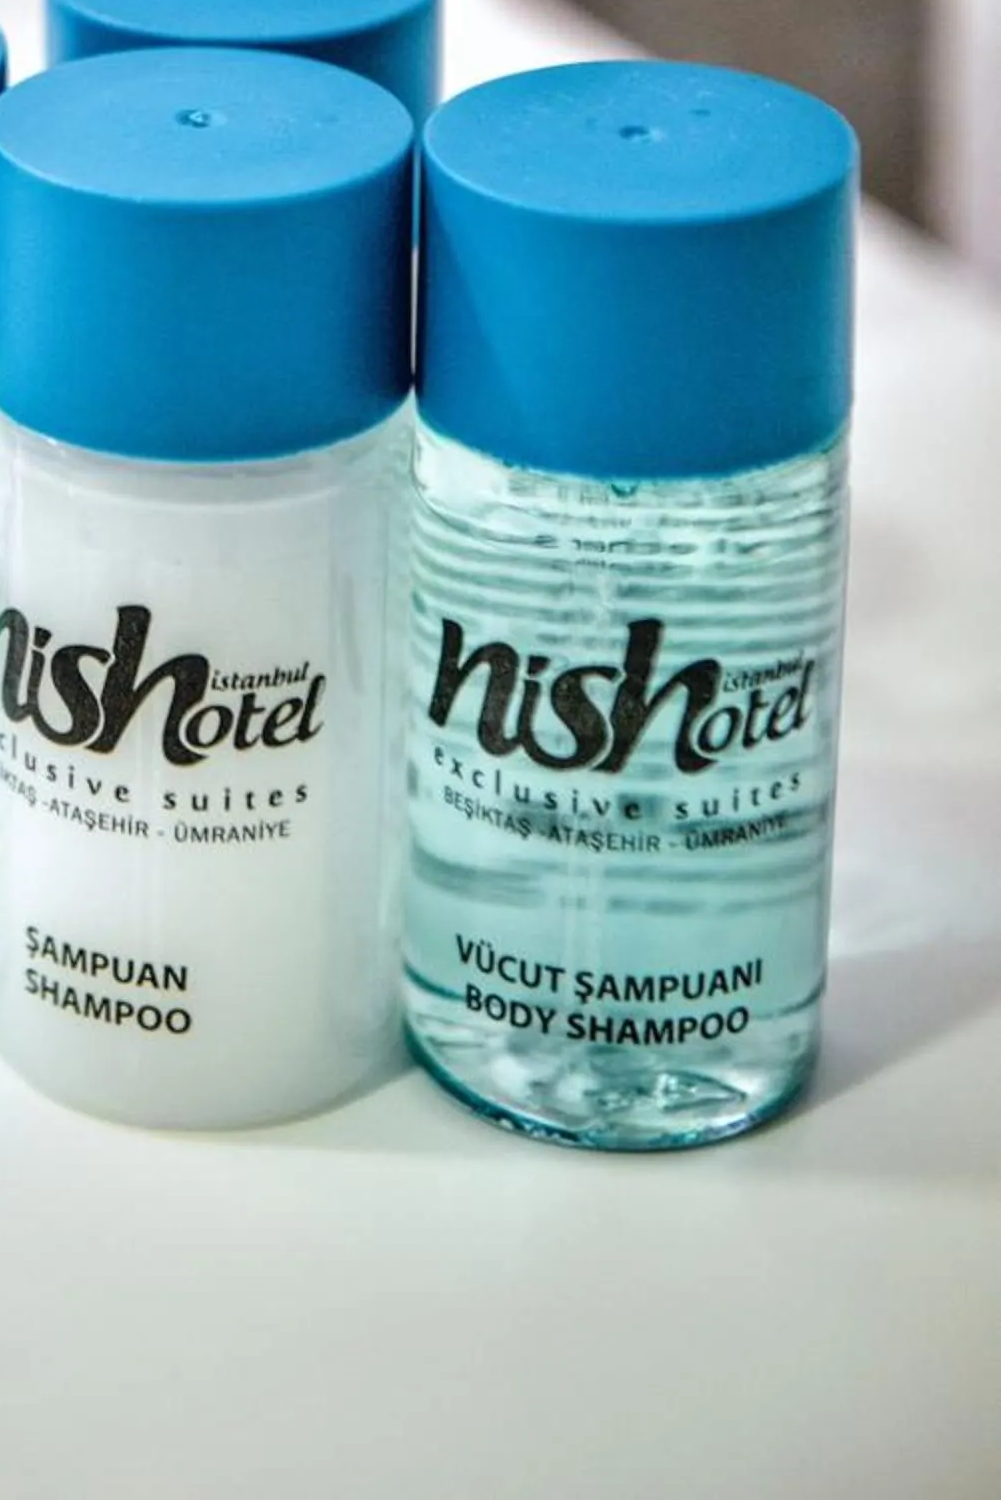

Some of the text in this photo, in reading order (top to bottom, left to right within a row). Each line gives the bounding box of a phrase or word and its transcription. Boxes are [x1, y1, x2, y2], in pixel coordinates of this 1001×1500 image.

[211, 661, 310, 691] istanbul
[163, 783, 308, 812] suites
[434, 747, 801, 819] exclusive suites
[174, 819, 291, 844] ÜMRANİYE
[25, 925, 188, 992] ŞAMPUAN
[456, 933, 763, 1004] VÜCUT ŞAMPUANI
[25, 968, 192, 1034] SHAMPOO
[466, 983, 750, 1046] BODY SHAMPOO
